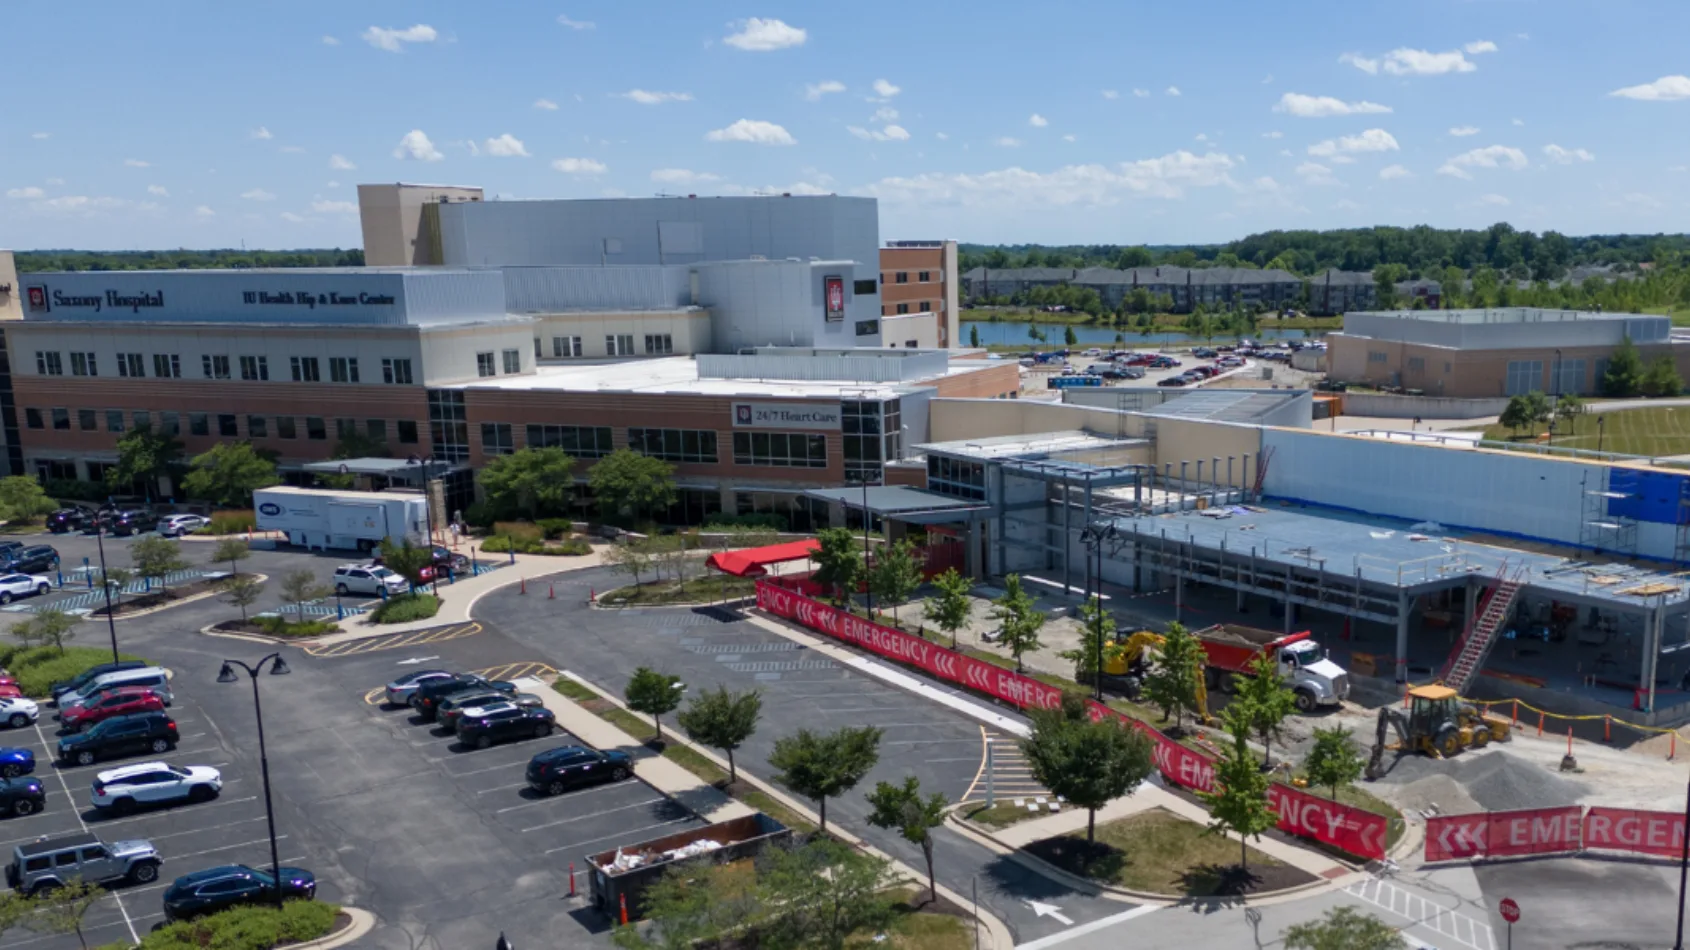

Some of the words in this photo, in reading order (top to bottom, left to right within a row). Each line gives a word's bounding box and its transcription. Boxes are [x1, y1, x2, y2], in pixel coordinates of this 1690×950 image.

[53, 290, 102, 312] Saxony
[105, 290, 164, 312] Hospital
[258, 291, 294, 304] Health
[296, 292, 316, 309] Hip
[319, 294, 328, 304] &
[756, 410, 778, 421] 24/7
[781, 411, 811, 422] Heart
[812, 412, 837, 423] Care
[844, 617, 929, 664] EMERGENCY
[1501, 903, 1520, 915] STOP
